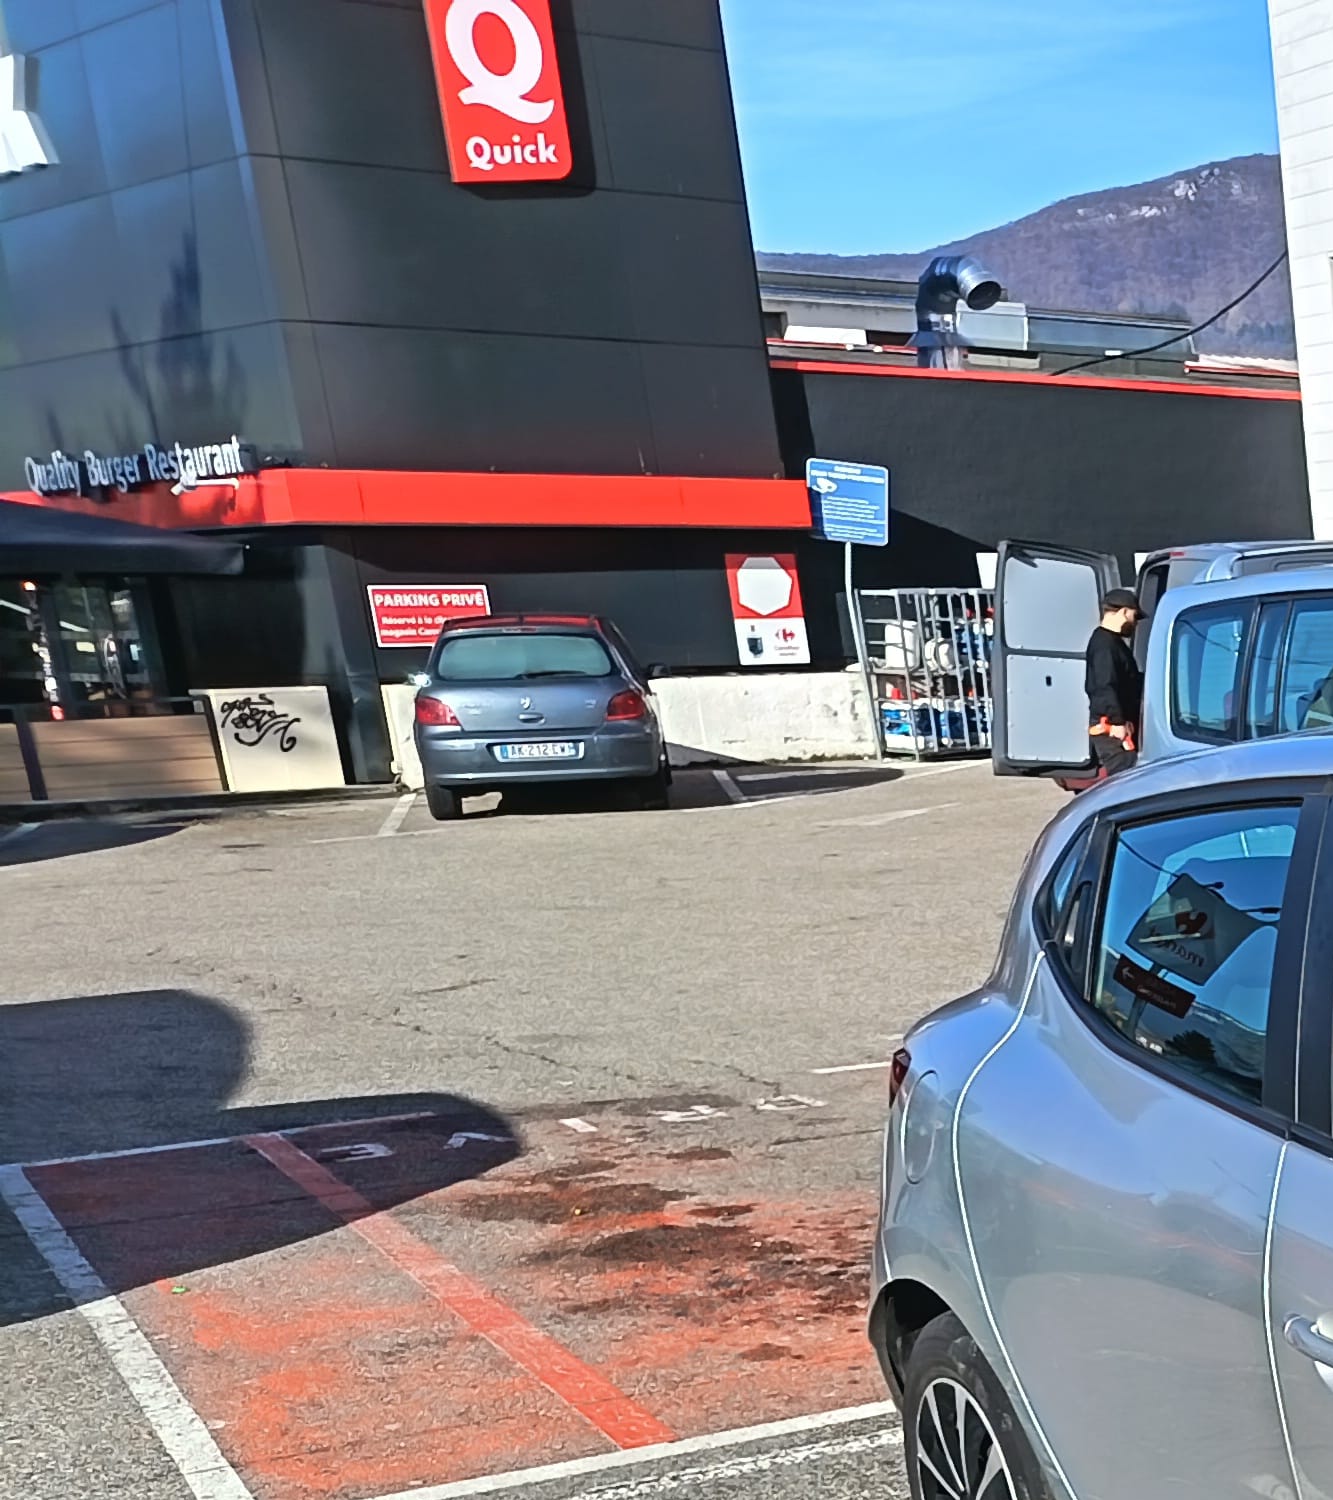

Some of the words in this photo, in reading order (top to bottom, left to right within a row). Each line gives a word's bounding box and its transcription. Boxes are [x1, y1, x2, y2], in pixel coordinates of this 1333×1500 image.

[466, 133, 558, 171] Quick
[25, 450, 82, 497] Quality
[84, 450, 140, 493] Burger
[144, 435, 244, 481] Restaurant
[374, 593, 440, 607] PARKING
[442, 591, 485, 607] PRIVÉ
